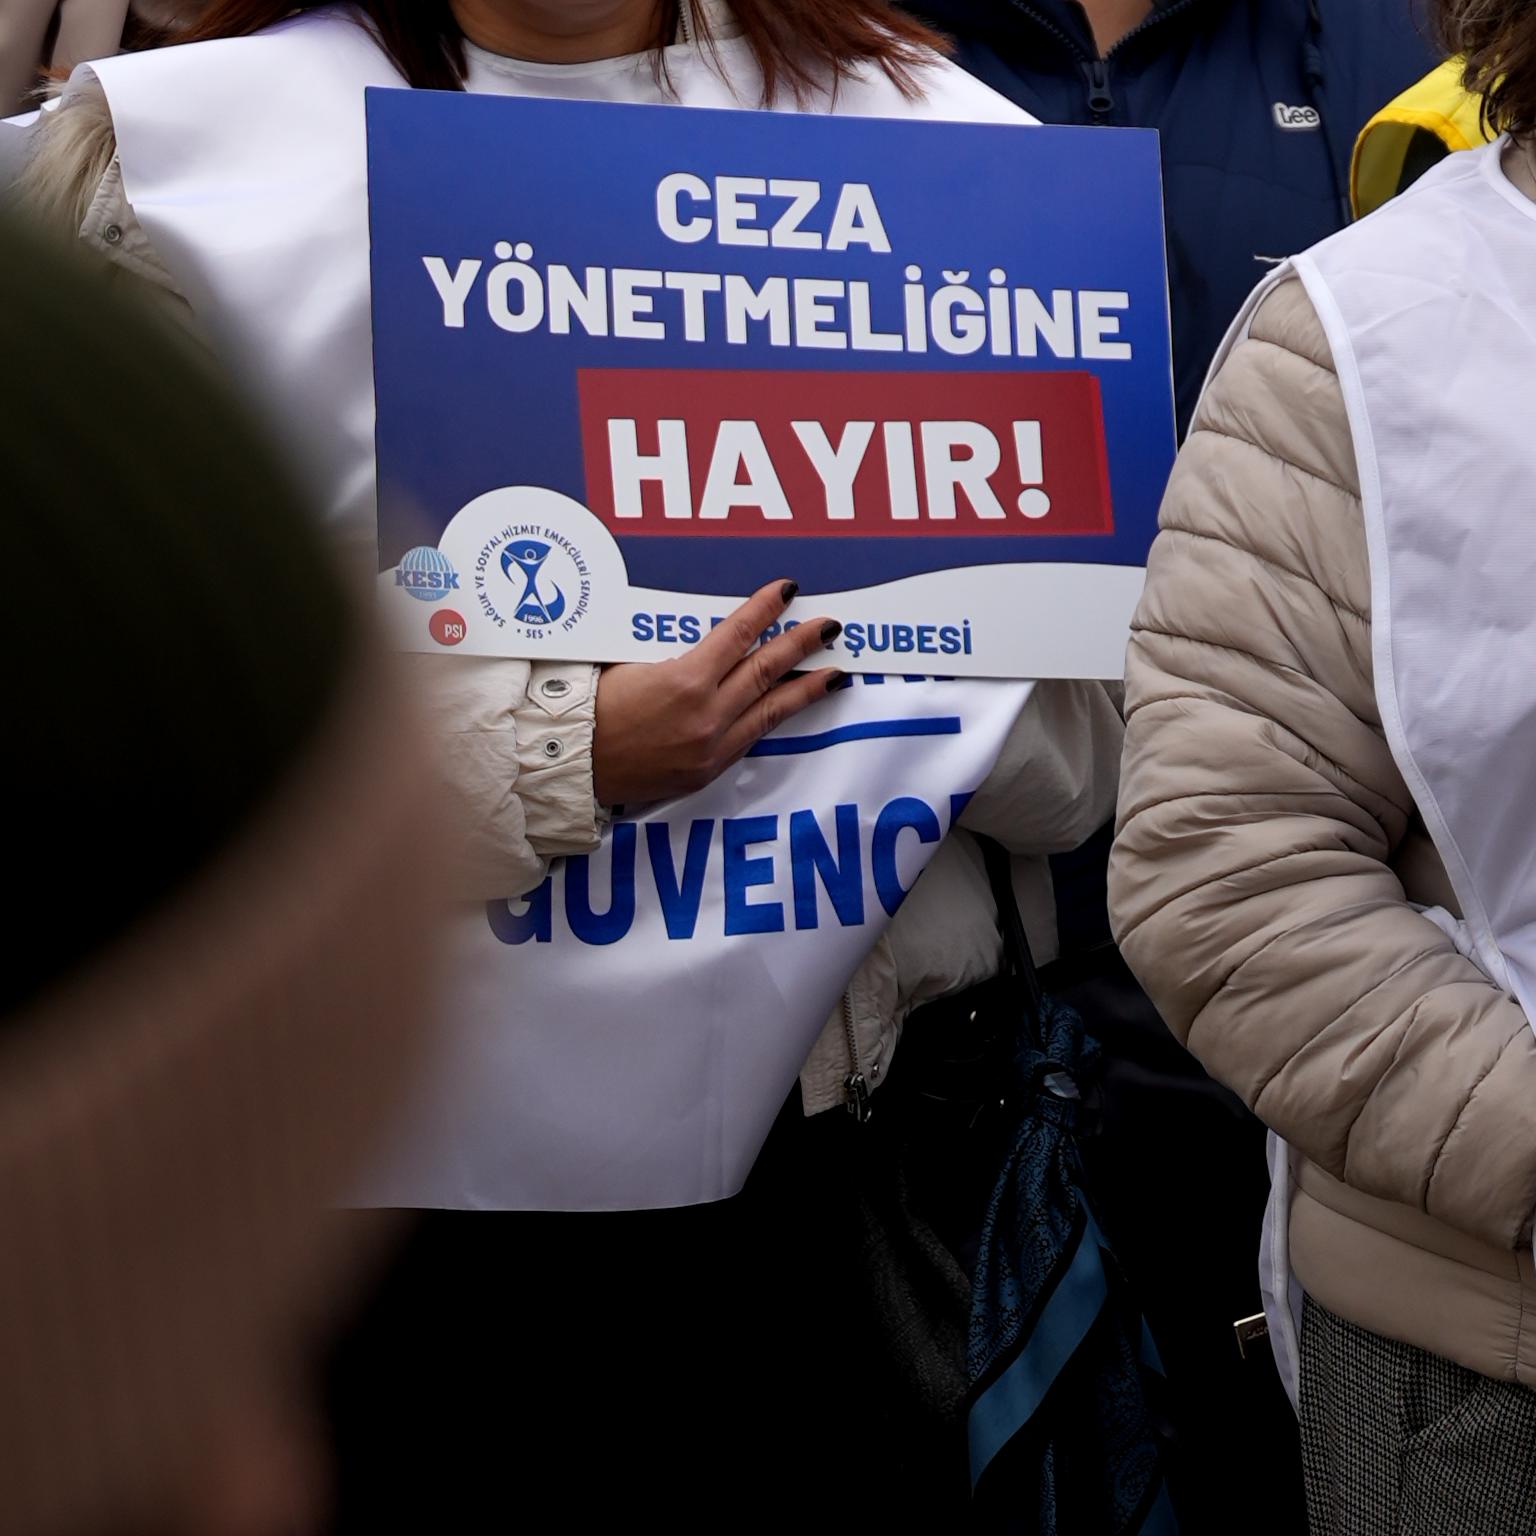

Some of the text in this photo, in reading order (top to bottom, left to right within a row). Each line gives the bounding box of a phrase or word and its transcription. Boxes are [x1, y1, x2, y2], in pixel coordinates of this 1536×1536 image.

[1279, 107, 1318, 124] Lee
[656, 172, 892, 254] CEZA
[422, 241, 1133, 360] YÖNETMELİĞİNE
[607, 417, 1052, 521] HAYIR!
[395, 569, 460, 589] KESK
[475, 524, 591, 631] SAĞLIK VE SOSYAL HİZMET EMEKÇİLERİ SENDİKASI
[444, 623, 463, 639] PSI
[526, 629, 544, 639] SES
[631, 612, 701, 644] SES
[844, 619, 972, 658] ŞUBESİ
[486, 791, 976, 946] GÜVENC
